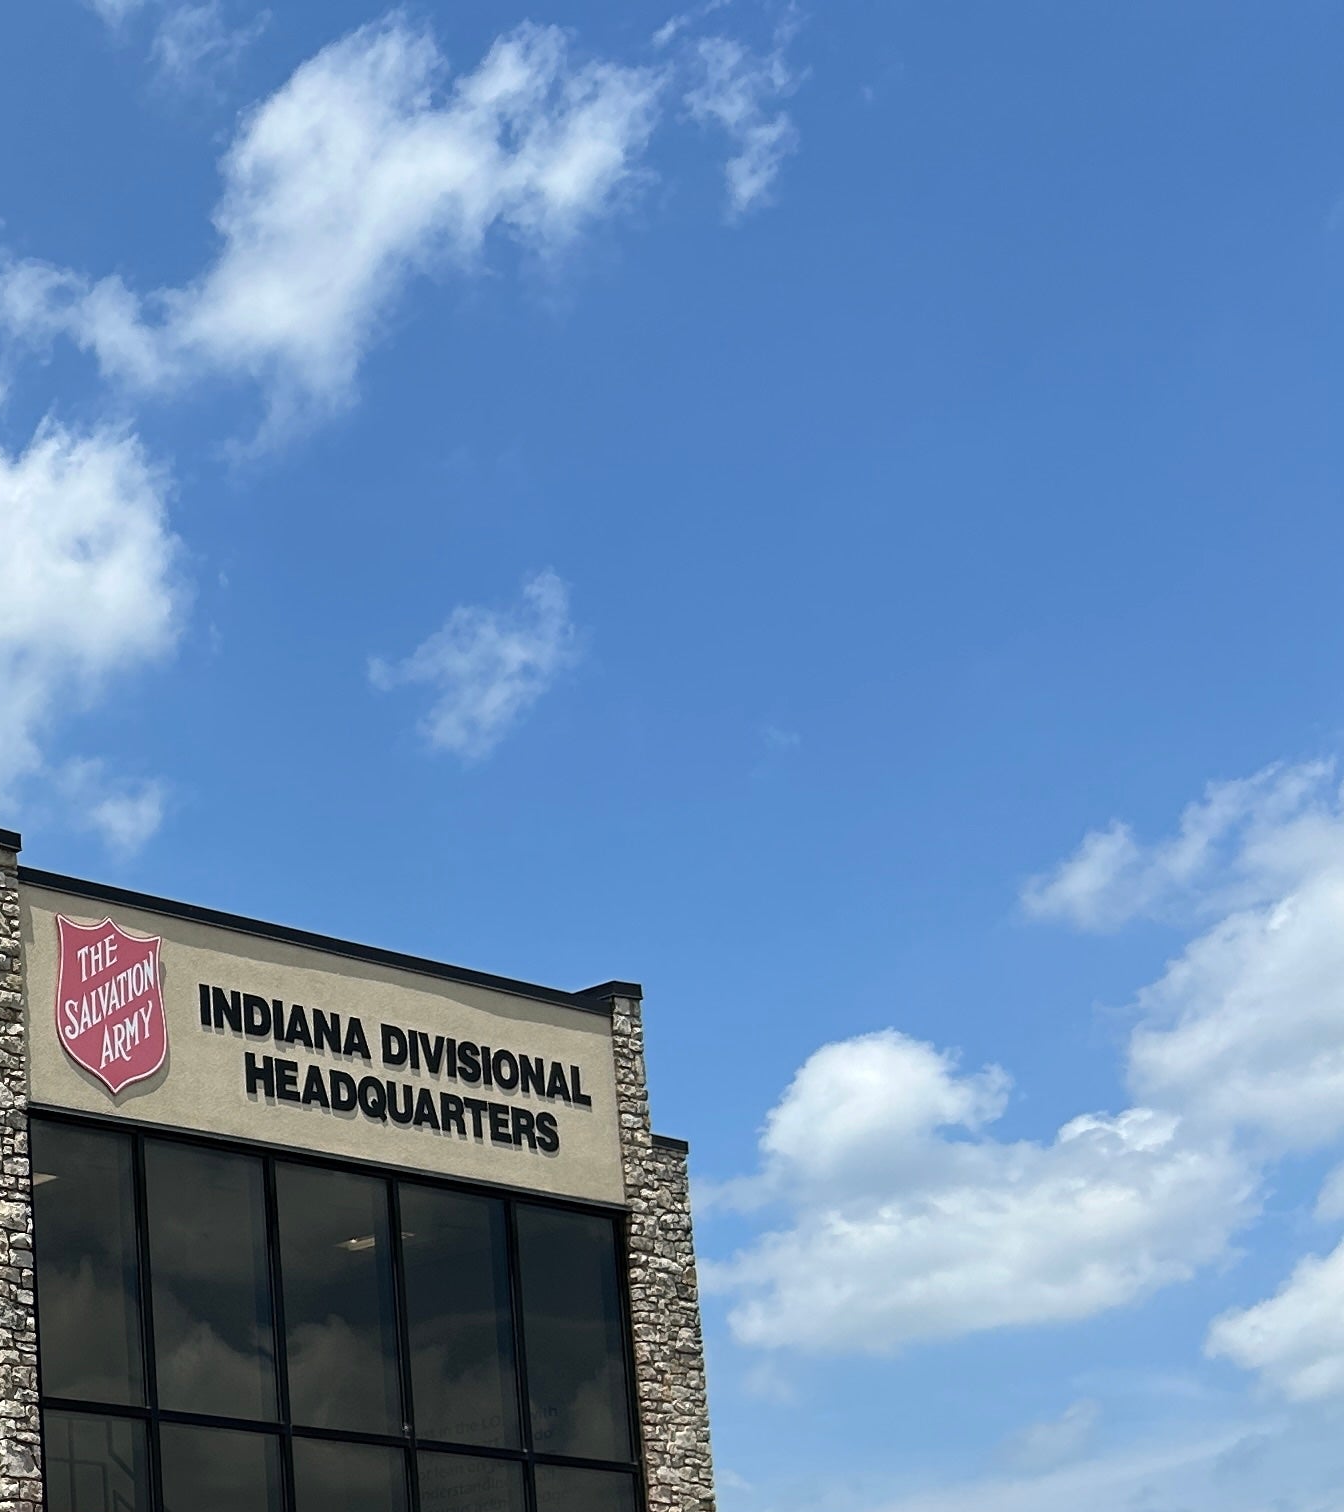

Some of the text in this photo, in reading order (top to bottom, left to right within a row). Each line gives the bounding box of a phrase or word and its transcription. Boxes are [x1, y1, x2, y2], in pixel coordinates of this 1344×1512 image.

[64, 950, 155, 1040] SALVATION
[77, 933, 118, 983] THE
[99, 1000, 153, 1070] ARMY
[198, 983, 592, 1107] INDIANA DIVISIONAL
[244, 1052, 560, 1153] HEADQUARTERS
